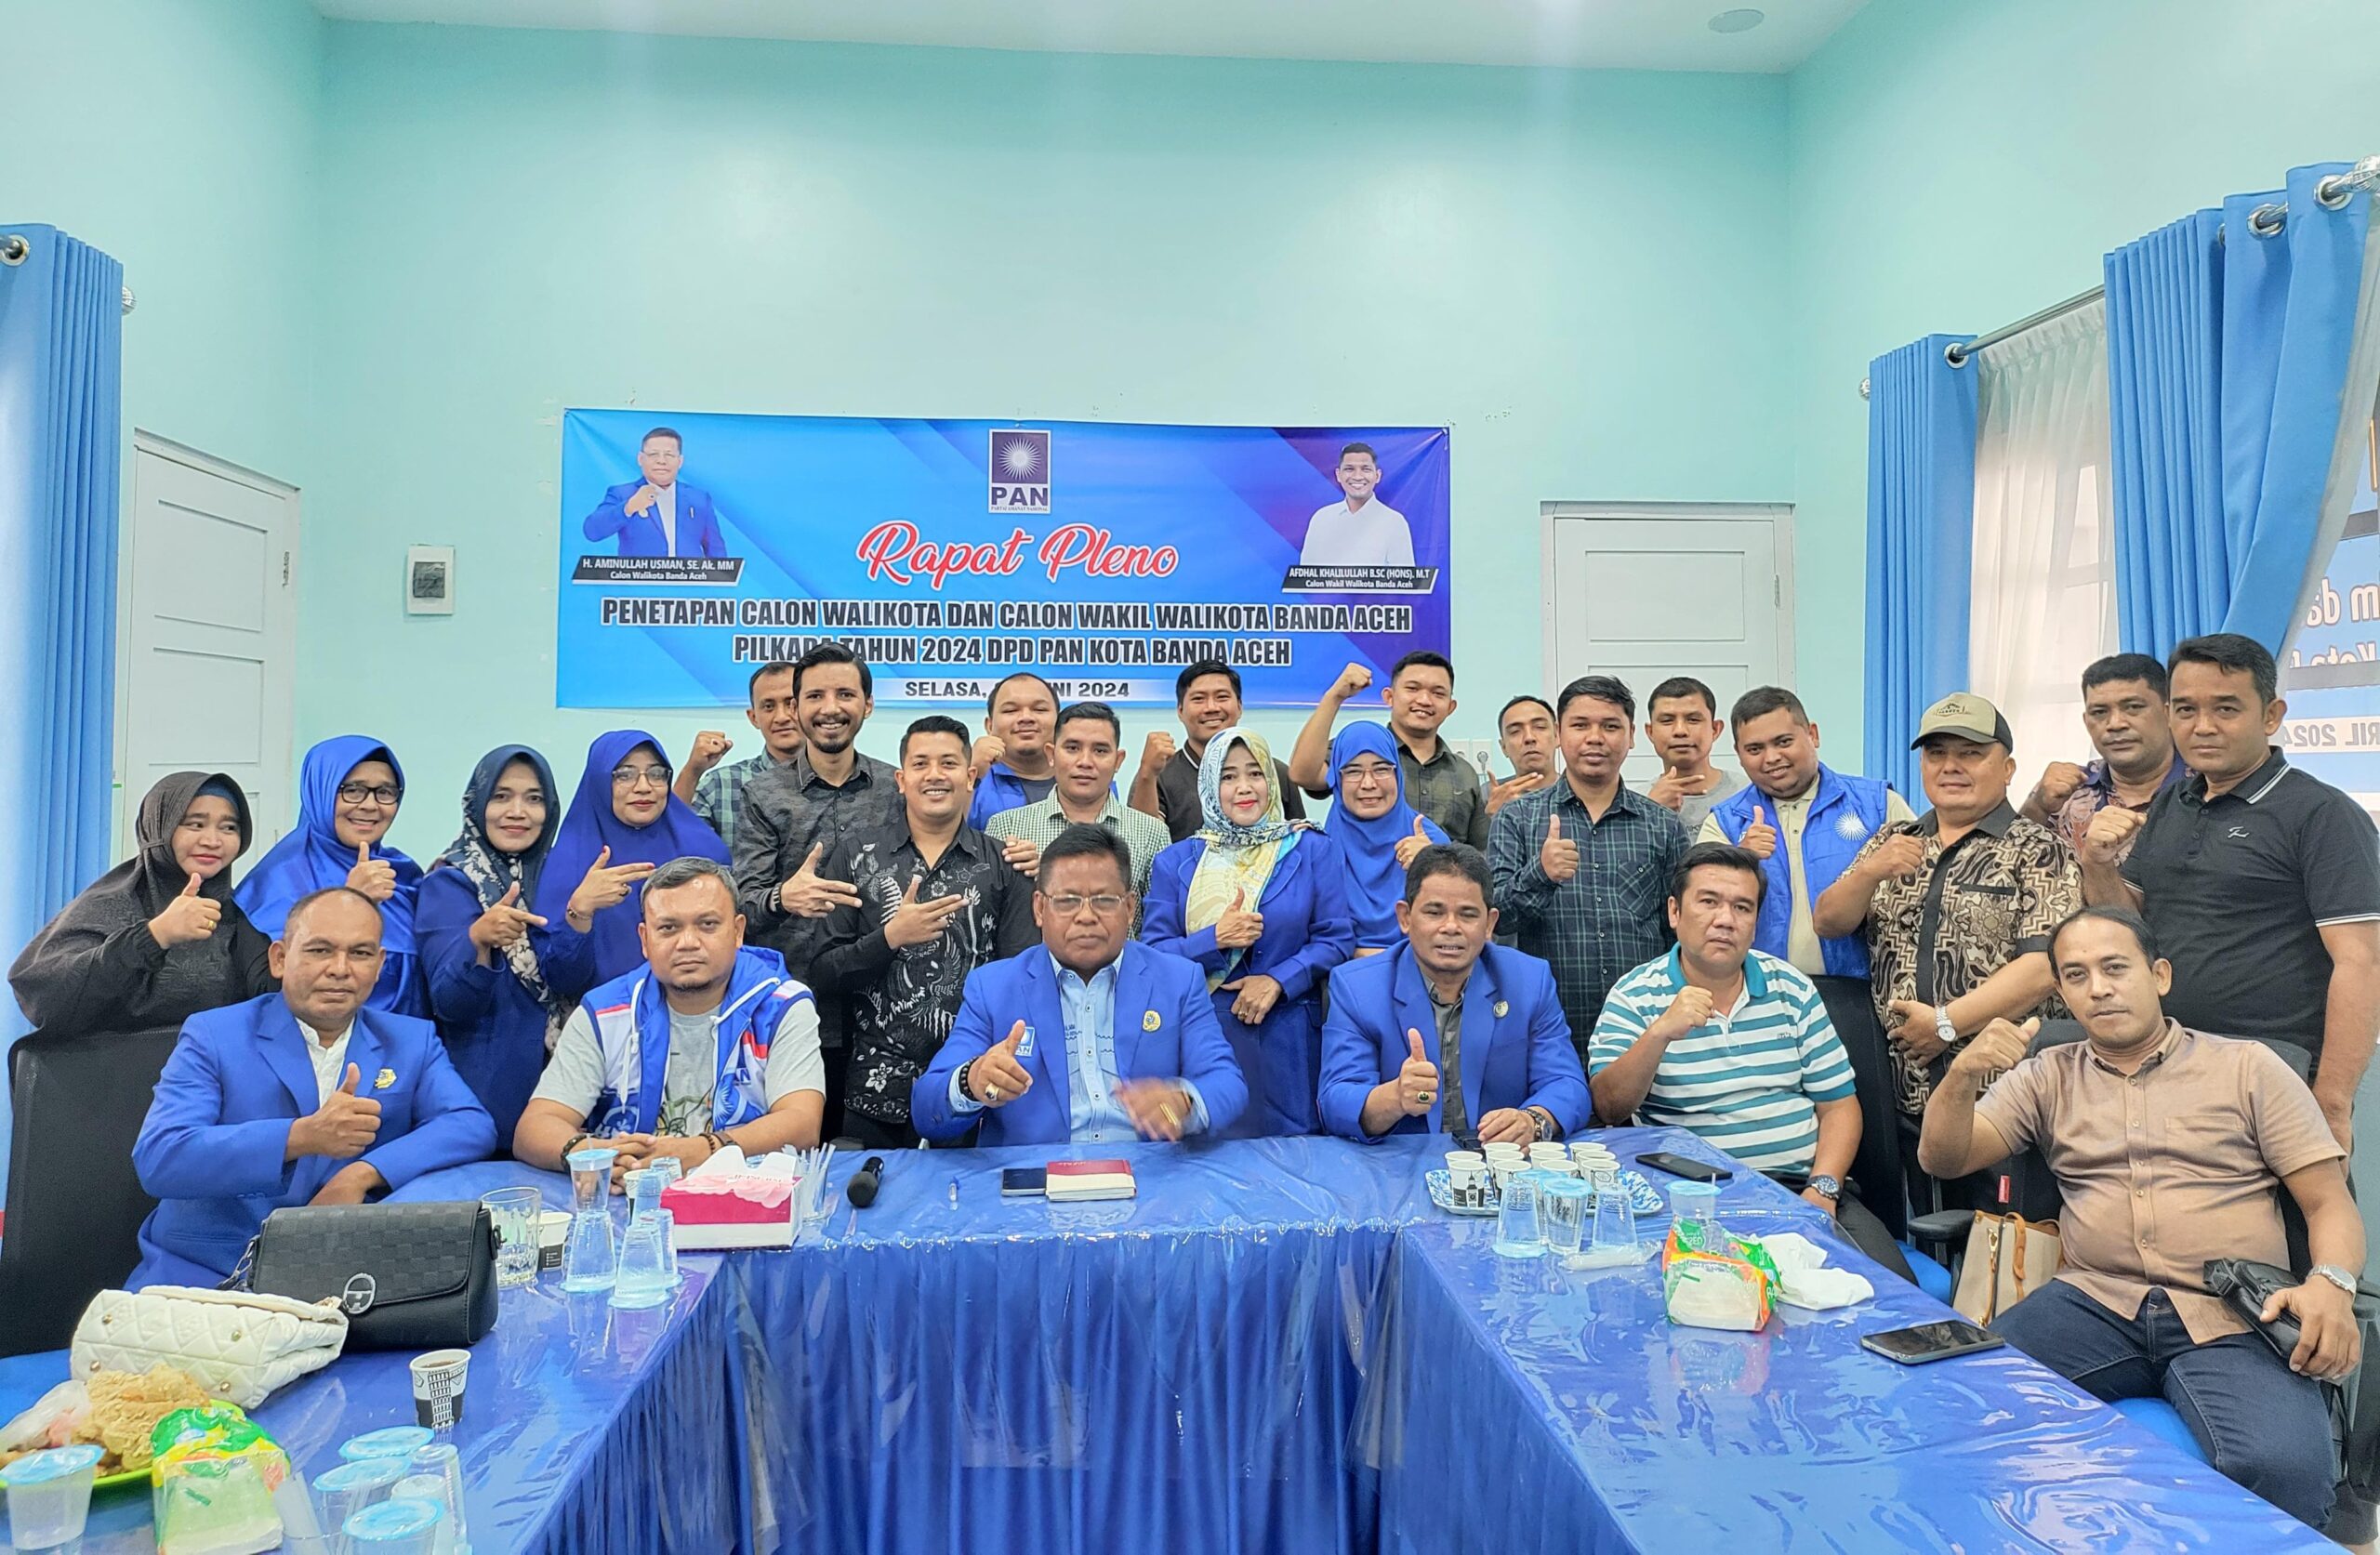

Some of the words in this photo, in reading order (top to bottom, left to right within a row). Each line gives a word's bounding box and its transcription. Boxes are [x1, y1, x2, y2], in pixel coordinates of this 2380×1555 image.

[991, 486, 1049, 507] PAN
[582, 558, 593, 569] H.
[594, 558, 649, 570] AMINULLAH
[650, 559, 685, 571] USMAN,
[717, 560, 734, 571] MM
[856, 521, 1032, 589] Rapat
[1038, 523, 1178, 582] Pleno
[610, 571, 631, 580] Calon
[632, 571, 664, 580] Walikota
[665, 572, 688, 581] Banda
[689, 572, 707, 581] Aceh
[1289, 567, 1318, 578] AFDHAL
[1319, 568, 1368, 578] KHALILULLAH
[1416, 569, 1430, 579] M.T
[1305, 579, 1325, 588] Calon
[1325, 579, 1344, 588] Wakil
[1345, 579, 1375, 588] Walikota
[1375, 580, 1395, 588] Banda
[1396, 580, 1413, 588] Aceh
[602, 598, 736, 626] PENETAPAN
[741, 600, 817, 626] CALON
[822, 600, 943, 627] WALIKOTA
[945, 602, 994, 628] DAN
[998, 602, 1071, 628] CALON
[1076, 603, 1152, 629] WAKIL
[1156, 604, 1270, 630] WALIKOTA
[1273, 605, 1351, 631] BANDA
[1353, 606, 1411, 632] ACEH
[734, 636, 833, 662] PILKAD
[839, 637, 917, 663] TAHUN
[921, 638, 983, 663] 2024
[987, 639, 1034, 664] DPD
[1038, 639, 1085, 664] PAN
[1090, 639, 1149, 665] KOTA
[1151, 639, 1229, 665] BANDA
[1232, 639, 1290, 665] ACEH
[905, 680, 987, 699] SELASA,
[1078, 681, 1130, 697] 2024
